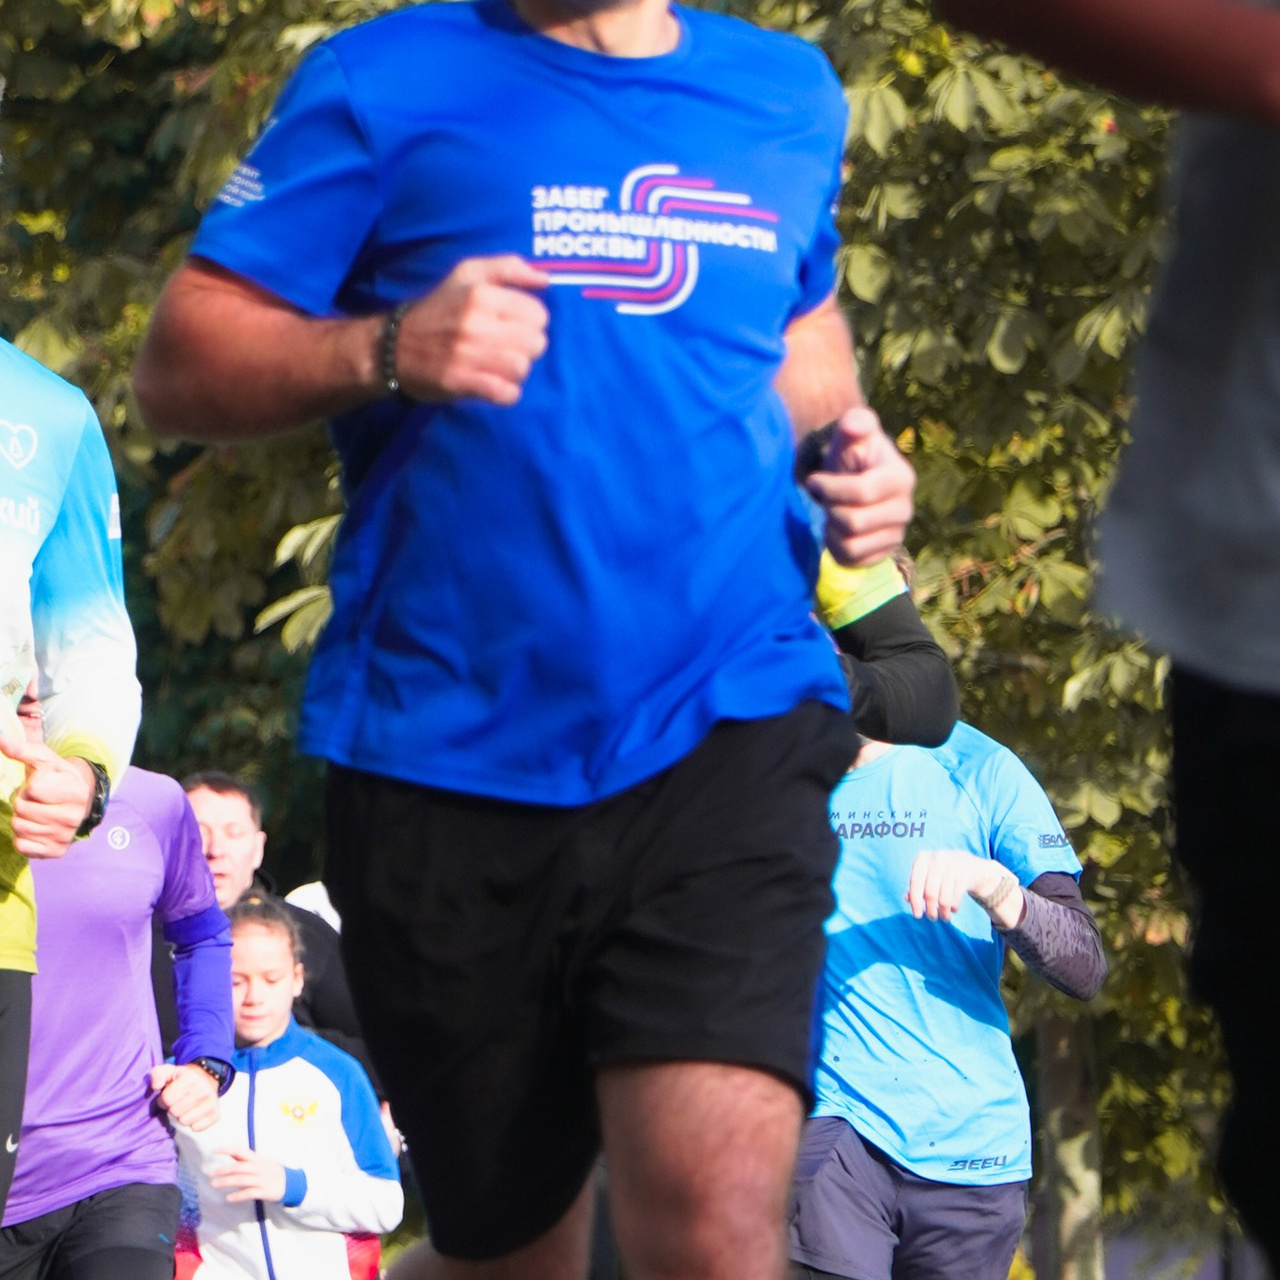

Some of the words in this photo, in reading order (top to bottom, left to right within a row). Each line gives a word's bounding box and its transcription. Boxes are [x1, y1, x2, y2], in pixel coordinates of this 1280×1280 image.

[531, 186, 609, 209] ЗАБЕГ
[533, 211, 778, 253] ПРОМЫШЛЕННОСТИ
[533, 234, 646, 259] МОСКВЫ
[835, 821, 926, 839] АРАФОН
